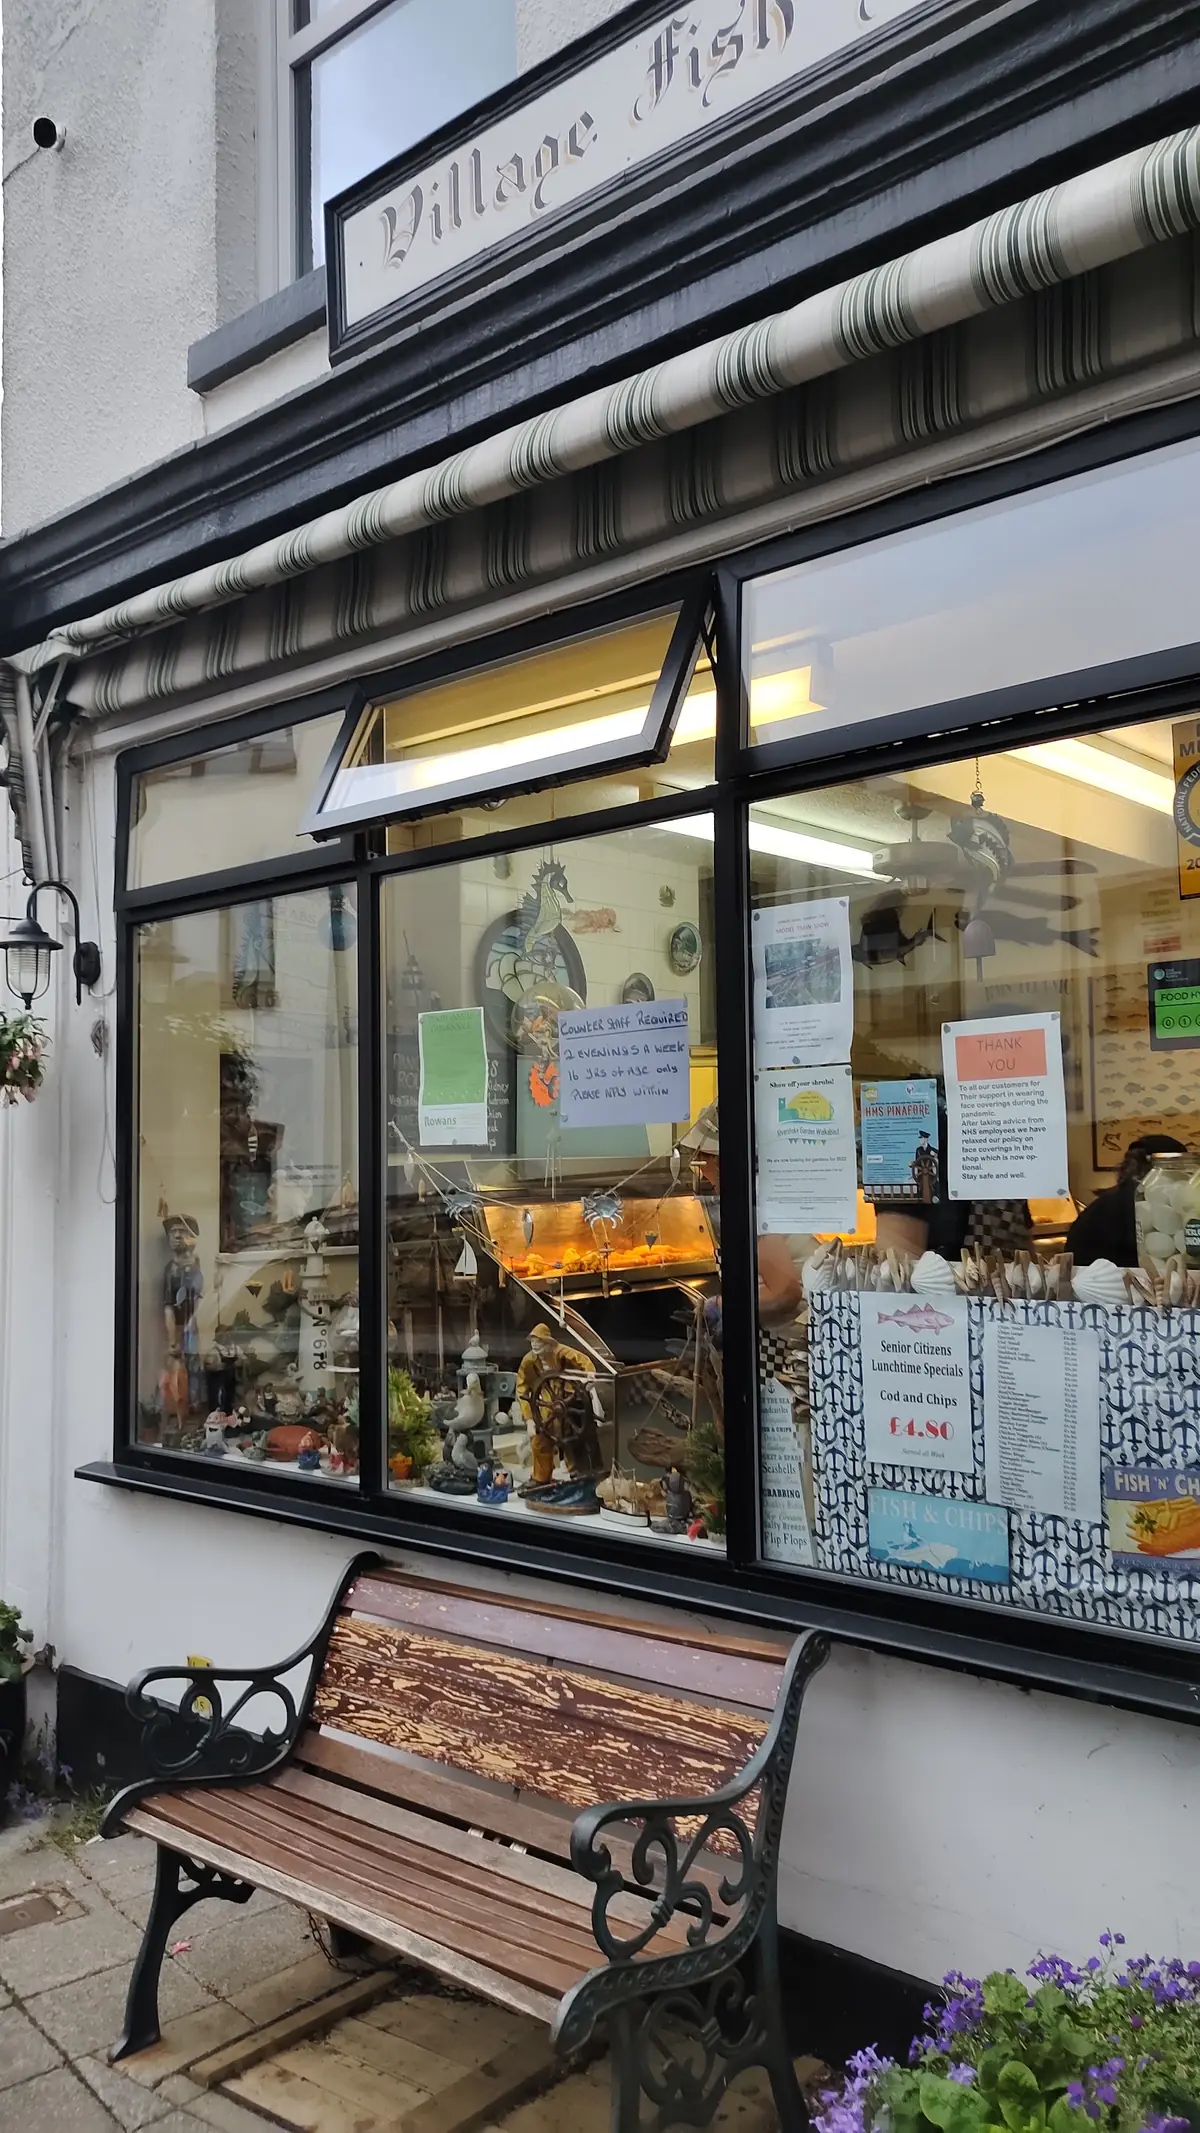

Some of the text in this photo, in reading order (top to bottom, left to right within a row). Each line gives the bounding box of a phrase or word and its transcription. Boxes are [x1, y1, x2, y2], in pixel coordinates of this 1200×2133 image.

[380, 0, 795, 269] Village Fish
[1176, 790, 1192, 833] NATIONAL
[1160, 991, 1188, 1001] FOOD
[636, 1010, 688, 1026] REQUIRED
[976, 1037, 1023, 1051] THANK
[564, 1049, 575, 1060] 2
[643, 1044, 651, 1054] A
[987, 1058, 1016, 1071] YOU
[568, 1070, 579, 1081] 16
[656, 1064, 678, 1074] only
[769, 1081, 786, 1089] Show
[796, 1081, 811, 1089] your
[812, 1078, 834, 1086] shrubs!
[991, 1081, 1029, 1090] customers
[960, 1093, 977, 1101] Their
[979, 1091, 1006, 1100] support
[1015, 1089, 1045, 1098] wearing
[976, 1100, 1010, 1108] coverings
[1012, 1098, 1036, 1107] during
[1037, 1097, 1049, 1105] the
[865, 1104, 930, 1118] HMS PINAFORE
[961, 1111, 996, 1119] pandemic.
[424, 1116, 457, 1127] Rowans
[980, 1119, 1001, 1127] taking
[1002, 1117, 1026, 1125] advice
[799, 1126, 815, 1135] Garden
[816, 1127, 840, 1136] Walkabout
[961, 1128, 977, 1136] NHS
[978, 1127, 1016, 1135] employees
[962, 1137, 987, 1145] relaxed
[1002, 1136, 1023, 1144] policy
[978, 1145, 1012, 1154] coverings
[962, 1155, 979, 1163] shop
[1026, 1154, 1038, 1162] op-
[962, 1163, 984, 1171] tional.
[961, 1172, 977, 1181] Stay
[1010, 1171, 1026, 1179] well.
[880, 1339, 952, 1357] Senior Citizens
[871, 1359, 964, 1379] Lunchtime Specials
[880, 1390, 958, 1409] Cod and Chips
[762, 1405, 788, 1414] andcastles
[888, 1415, 955, 1441] £4.80
[902, 1449, 920, 1457] Served
[930, 1450, 945, 1459] Week
[762, 1461, 796, 1475] Seashells
[1113, 1470, 1150, 1493] FISH
[763, 1487, 801, 1499] CRABBING
[869, 1494, 1008, 1536] FISH & CHIPS
[782, 1522, 806, 1532] Breeze
[765, 1531, 808, 1549] Flip Flops
